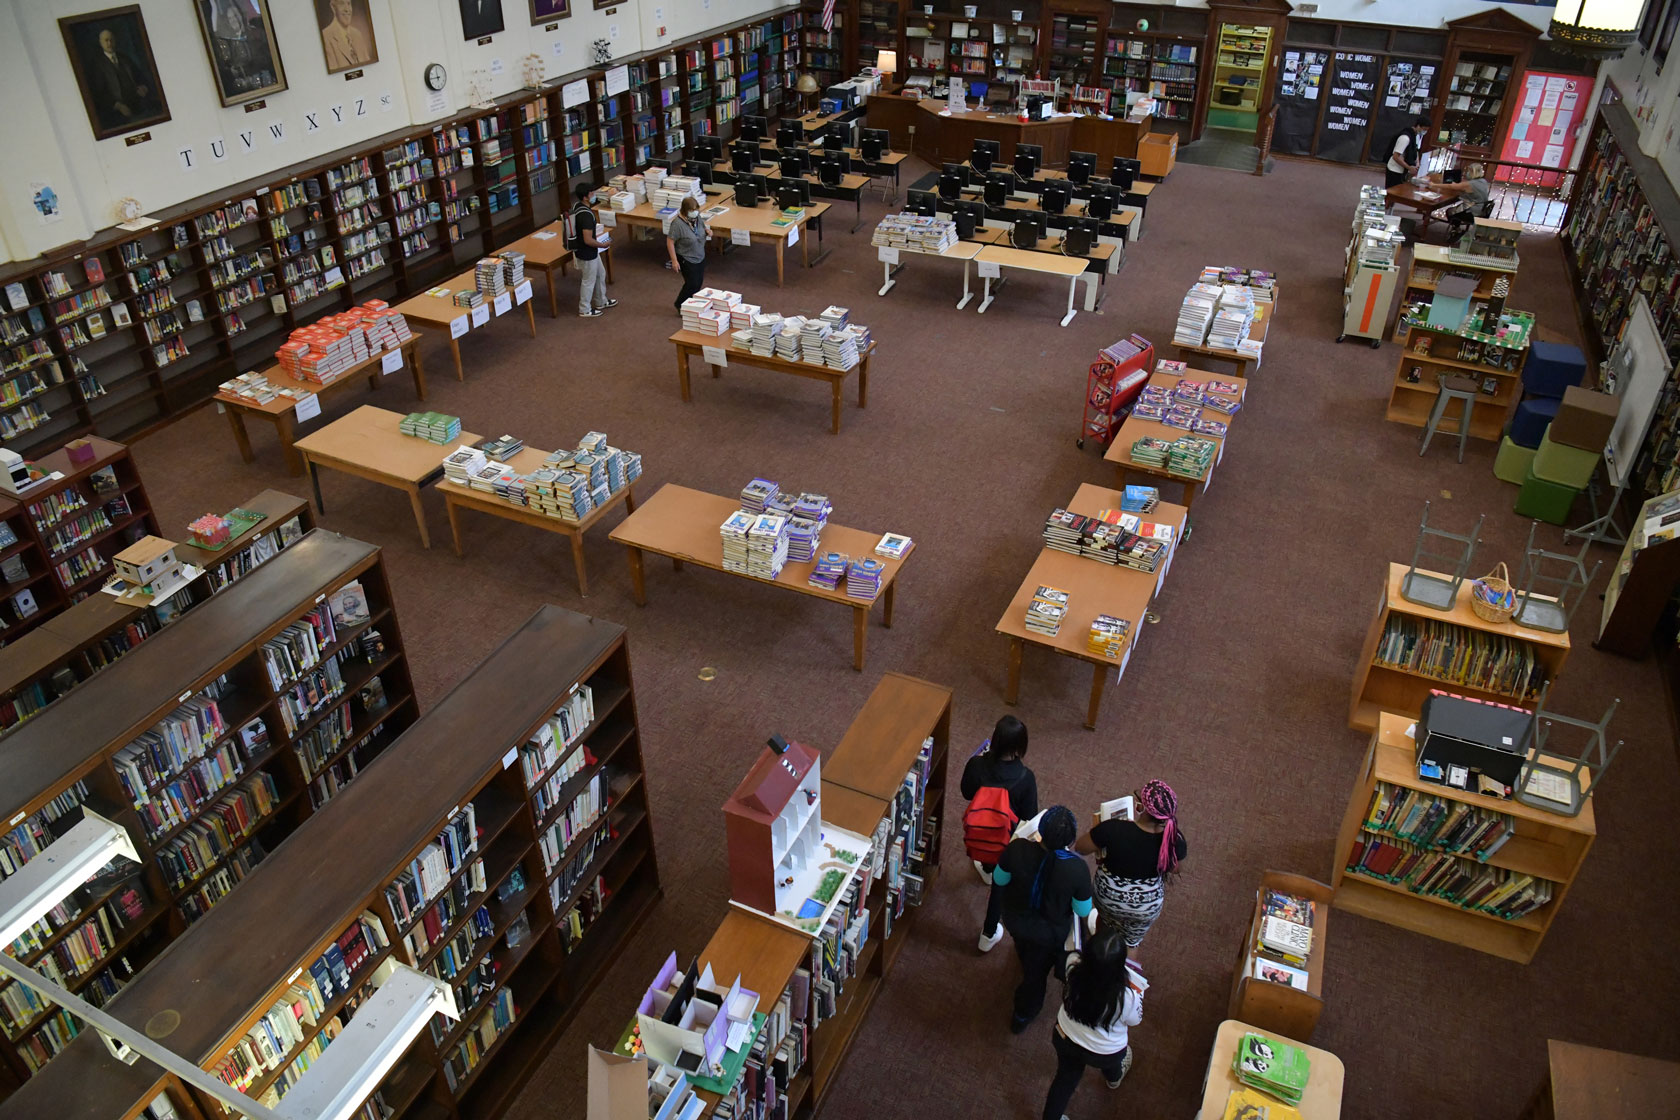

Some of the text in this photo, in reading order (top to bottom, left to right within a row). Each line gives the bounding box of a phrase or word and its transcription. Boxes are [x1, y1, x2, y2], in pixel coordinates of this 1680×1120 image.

[1355, 54, 1376, 63] WOMEN
[1340, 70, 1364, 80] WOMEN
[1331, 87, 1355, 97] WOMEN
[1347, 98, 1370, 109] WOMEN
[1329, 105, 1353, 115] WOMEN
[1343, 116, 1367, 126] WOMEN
[1327, 122, 1350, 131] WOMEN
[179, 149, 192, 167] T
[210, 140, 225, 158] U
[240, 131, 252, 149] V
[269, 123, 283, 139] W
[305, 112, 320, 131] X
[332, 106, 343, 122] Y
[355, 99, 366, 116] Z
[1289, 924, 1300, 947] CLINIC
[1299, 928, 1309, 949] MAYO
